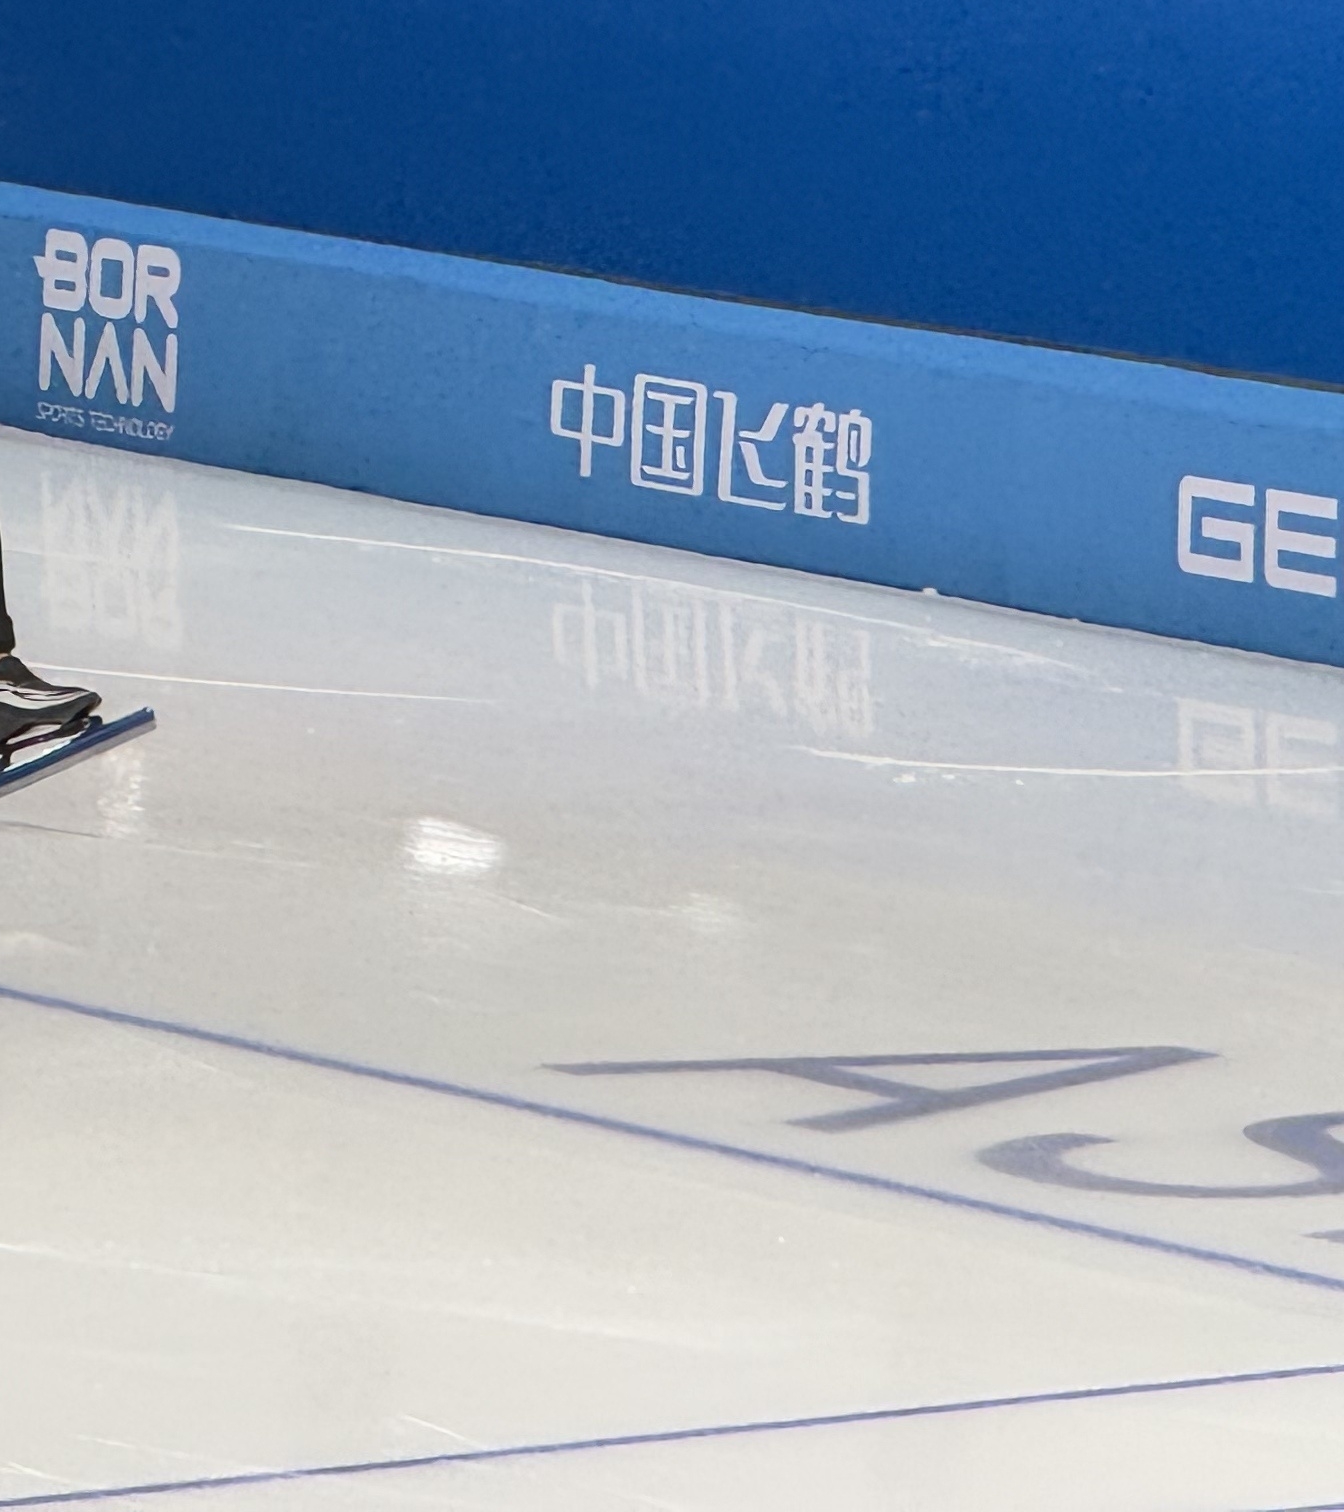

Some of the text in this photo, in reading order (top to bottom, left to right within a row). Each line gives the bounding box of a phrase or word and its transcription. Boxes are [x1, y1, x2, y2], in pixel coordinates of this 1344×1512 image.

[32, 228, 181, 328] BOR
[39, 311, 178, 413] NAN
[550, 363, 872, 525] 中国飞鹤
